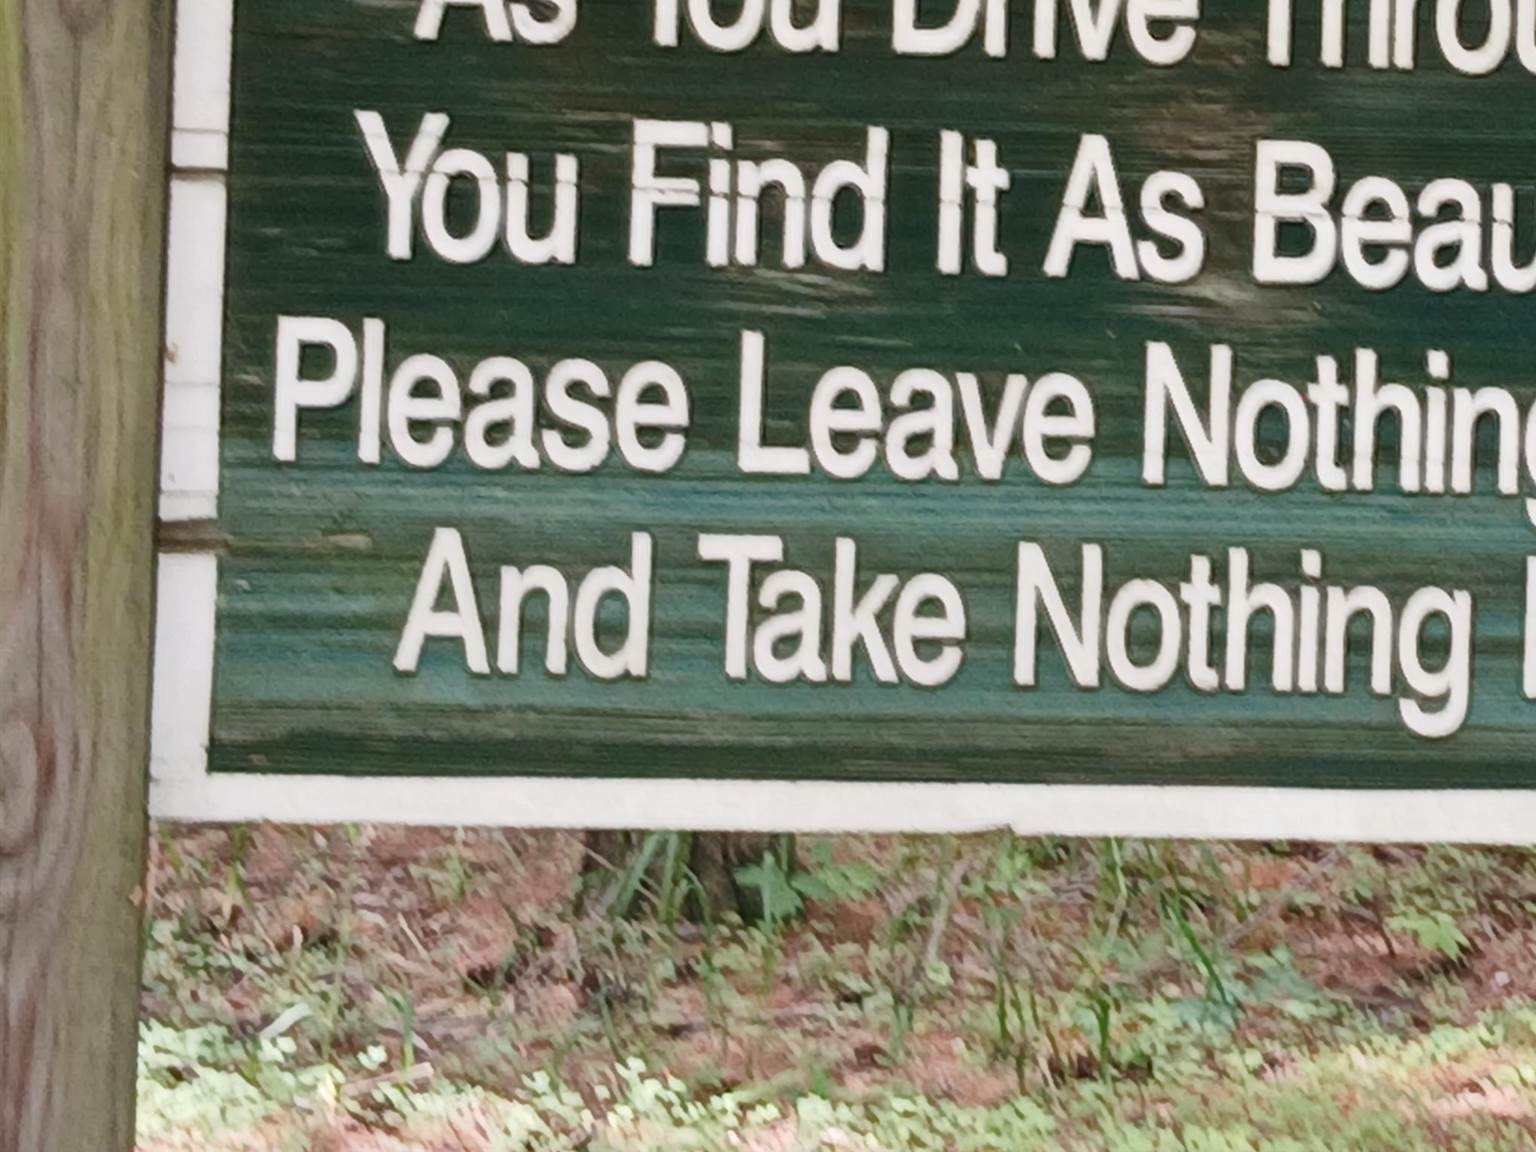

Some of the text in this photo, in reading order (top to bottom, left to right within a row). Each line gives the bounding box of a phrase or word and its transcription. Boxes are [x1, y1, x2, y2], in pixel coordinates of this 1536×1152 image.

[354, 109, 578, 265] You
[628, 118, 889, 272] Find
[937, 129, 1010, 277] It
[1042, 133, 1205, 284] As
[271, 314, 690, 473] Please
[736, 329, 1096, 485] Leave
[392, 526, 653, 680] And
[696, 532, 967, 687] Take
[1013, 540, 1473, 738] Nothing
